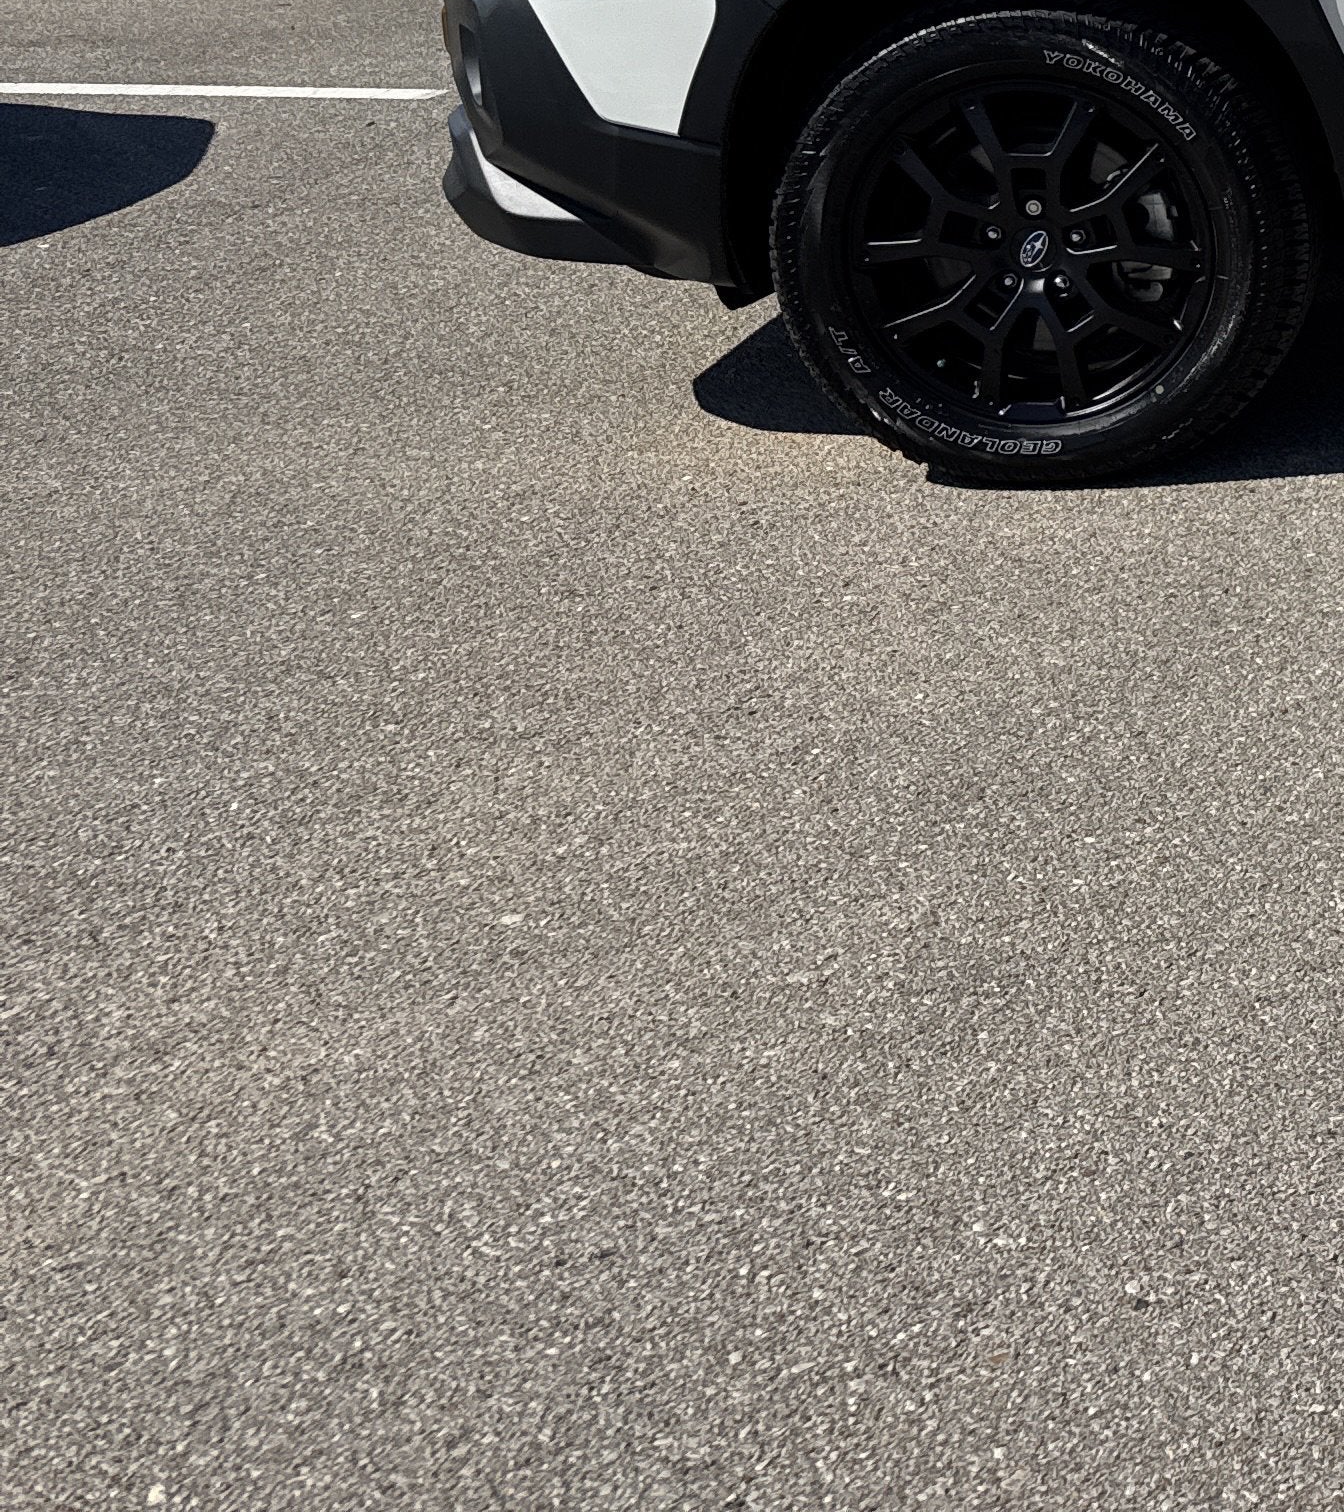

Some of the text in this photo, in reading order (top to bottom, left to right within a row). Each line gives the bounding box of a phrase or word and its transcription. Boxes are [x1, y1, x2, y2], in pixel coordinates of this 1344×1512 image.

[1043, 49, 1197, 141] YOKOHAMA
[828, 326, 1062, 455] GEOLANDAR A/T
